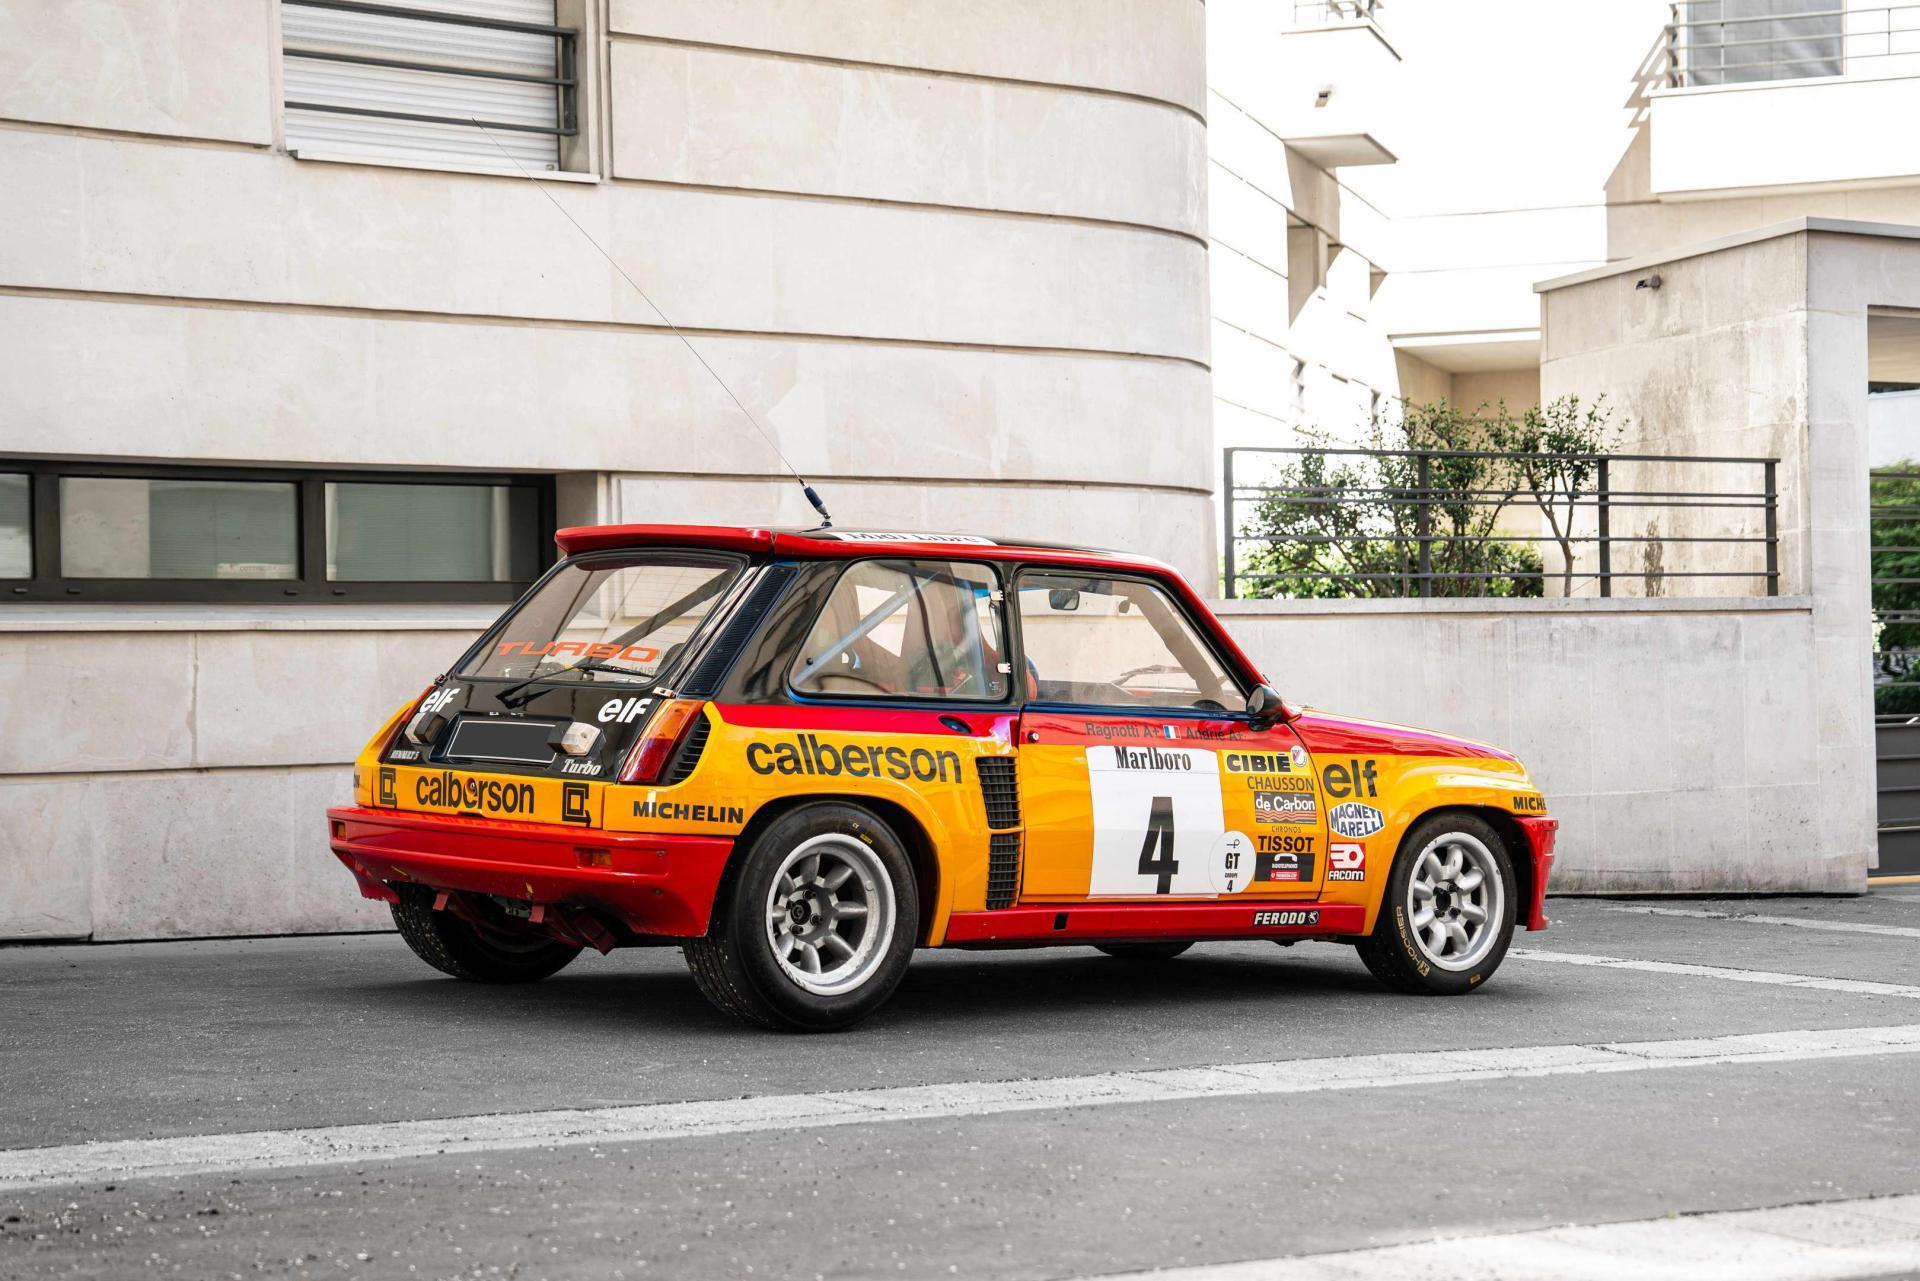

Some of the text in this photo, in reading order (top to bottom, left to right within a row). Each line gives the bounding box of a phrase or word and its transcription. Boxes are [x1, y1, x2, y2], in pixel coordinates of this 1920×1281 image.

[498, 641, 662, 662] TURBO
[420, 688, 461, 713] elf
[598, 697, 653, 723] elf
[1085, 722, 1140, 739] Ragnotti
[561, 758, 602, 776] Turbo
[746, 733, 963, 784] calberson
[1114, 745, 1192, 771] Marlboro
[1247, 775, 1315, 792] CHAUSSON
[1322, 759, 1378, 798] elf
[633, 799, 744, 824] MICHELIN
[1255, 795, 1316, 812] de Carbon
[1137, 796, 1180, 895] 4
[1257, 835, 1315, 852] TISSOT
[1225, 853, 1241, 869] GT
[1226, 880, 1233, 892] 4
[1254, 911, 1306, 925] FERODO
